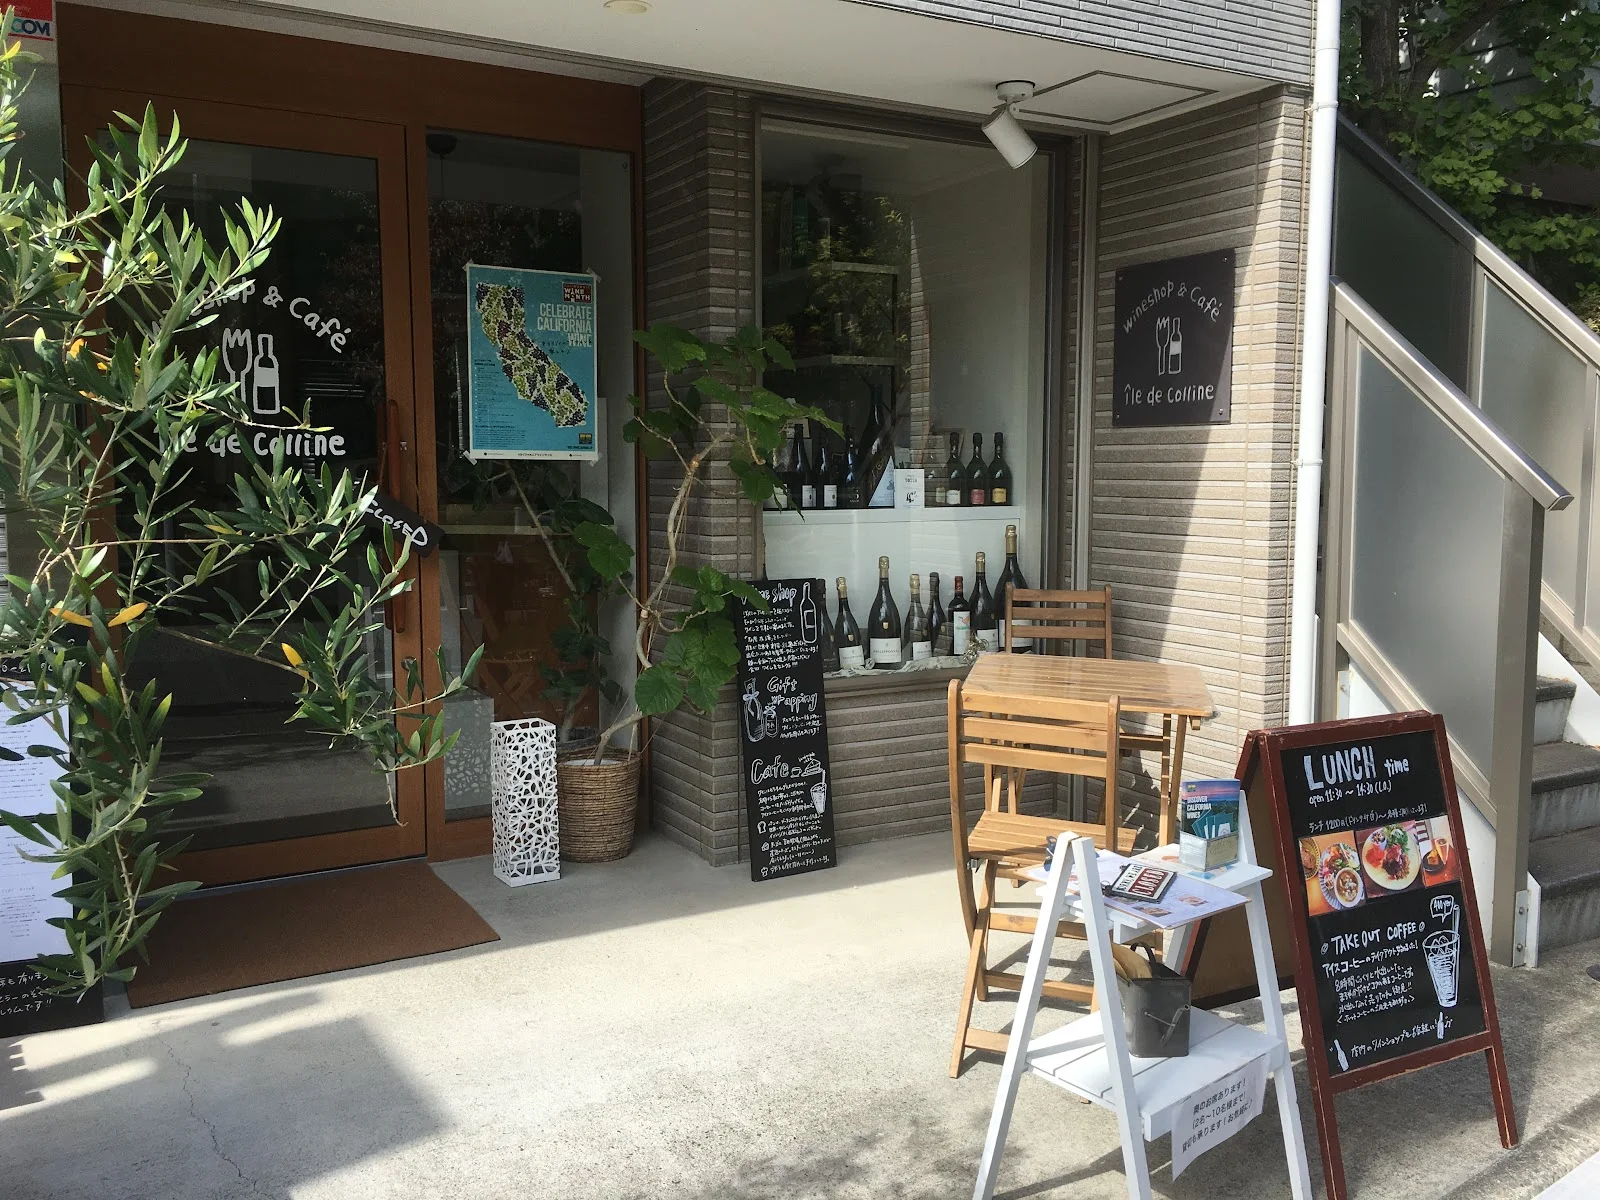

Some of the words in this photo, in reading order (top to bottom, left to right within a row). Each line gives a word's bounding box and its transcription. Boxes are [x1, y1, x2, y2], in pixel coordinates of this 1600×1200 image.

[10, 18, 51, 36] COM
[540, 303, 592, 320] CELEBRATE
[1177, 282, 1187, 297] &
[1190, 287, 1222, 322] Café
[263, 286, 284, 308] &
[290, 298, 351, 353] Café
[537, 317, 592, 334] CALIFORNIA
[568, 333, 592, 347] WINE
[1147, 385, 1163, 406] de
[1167, 384, 1214, 404] Colline
[772, 583, 797, 607] shop
[767, 676, 798, 694] Gift
[1303, 746, 1377, 790] LUNCH
[1384, 758, 1409, 778] time
[1187, 803, 1211, 811] CALIFORNIA
[1309, 795, 1324, 807] open
[1325, 788, 1342, 802] 11:30
[1187, 811, 1201, 819] WINES
[1131, 868, 1164, 895] CLOSED
[1331, 934, 1360, 955] TAKE
[1361, 928, 1381, 948] OUT
[1387, 922, 1417, 940] COFFEE
